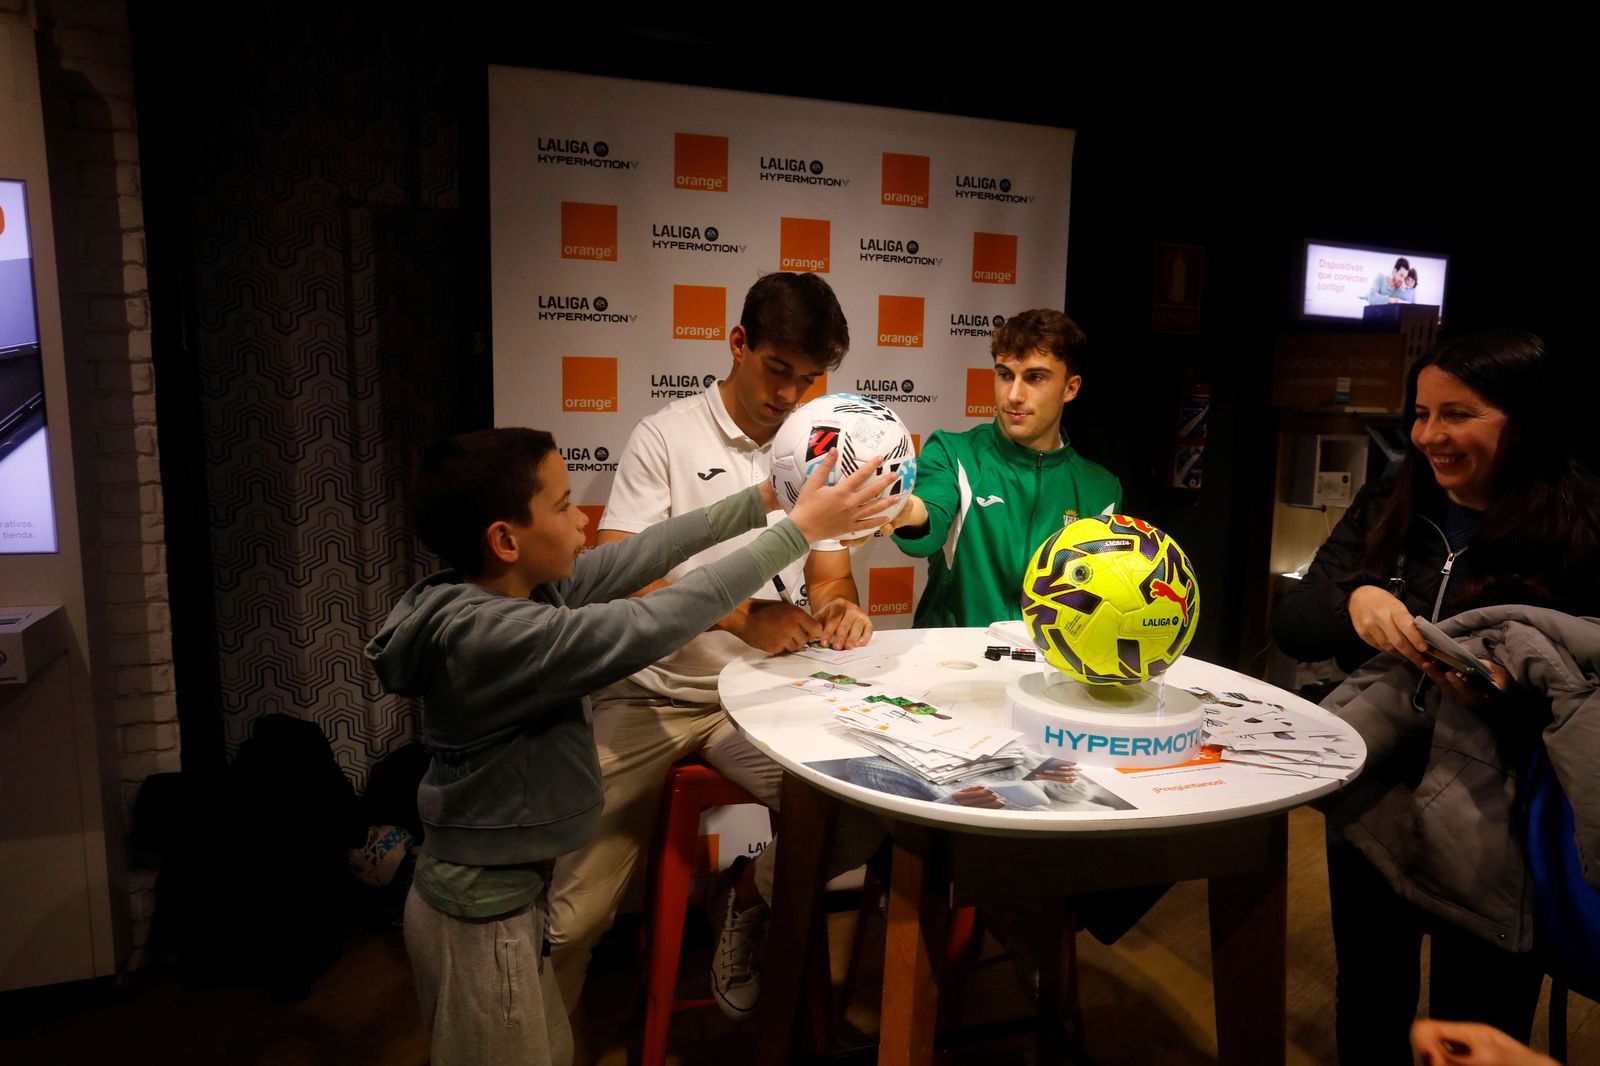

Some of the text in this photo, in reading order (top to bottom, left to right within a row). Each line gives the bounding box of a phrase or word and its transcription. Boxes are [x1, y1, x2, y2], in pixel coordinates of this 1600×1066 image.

[537, 137, 590, 155] LALIGA
[760, 156, 806, 173] LALIGA
[676, 176, 723, 189] orange
[956, 175, 997, 190] LALIGA
[883, 191, 925, 206] orange
[652, 224, 701, 239] LALIGA
[564, 245, 612, 258] orange
[860, 238, 903, 253] LALIGA
[782, 257, 825, 271] orange
[974, 269, 1011, 282] orange
[538, 295, 590, 310] LALIGA
[951, 313, 990, 327] LALIGA
[675, 325, 721, 338] orange
[950, 328, 992, 337] HYPERM
[879, 332, 919, 346] orange
[651, 374, 700, 388] LALIGA
[856, 379, 898, 392] LALIGA
[565, 398, 612, 411] orange
[967, 405, 998, 416] orang
[870, 602, 909, 613] orange
[1142, 617, 1171, 627] LALIGA
